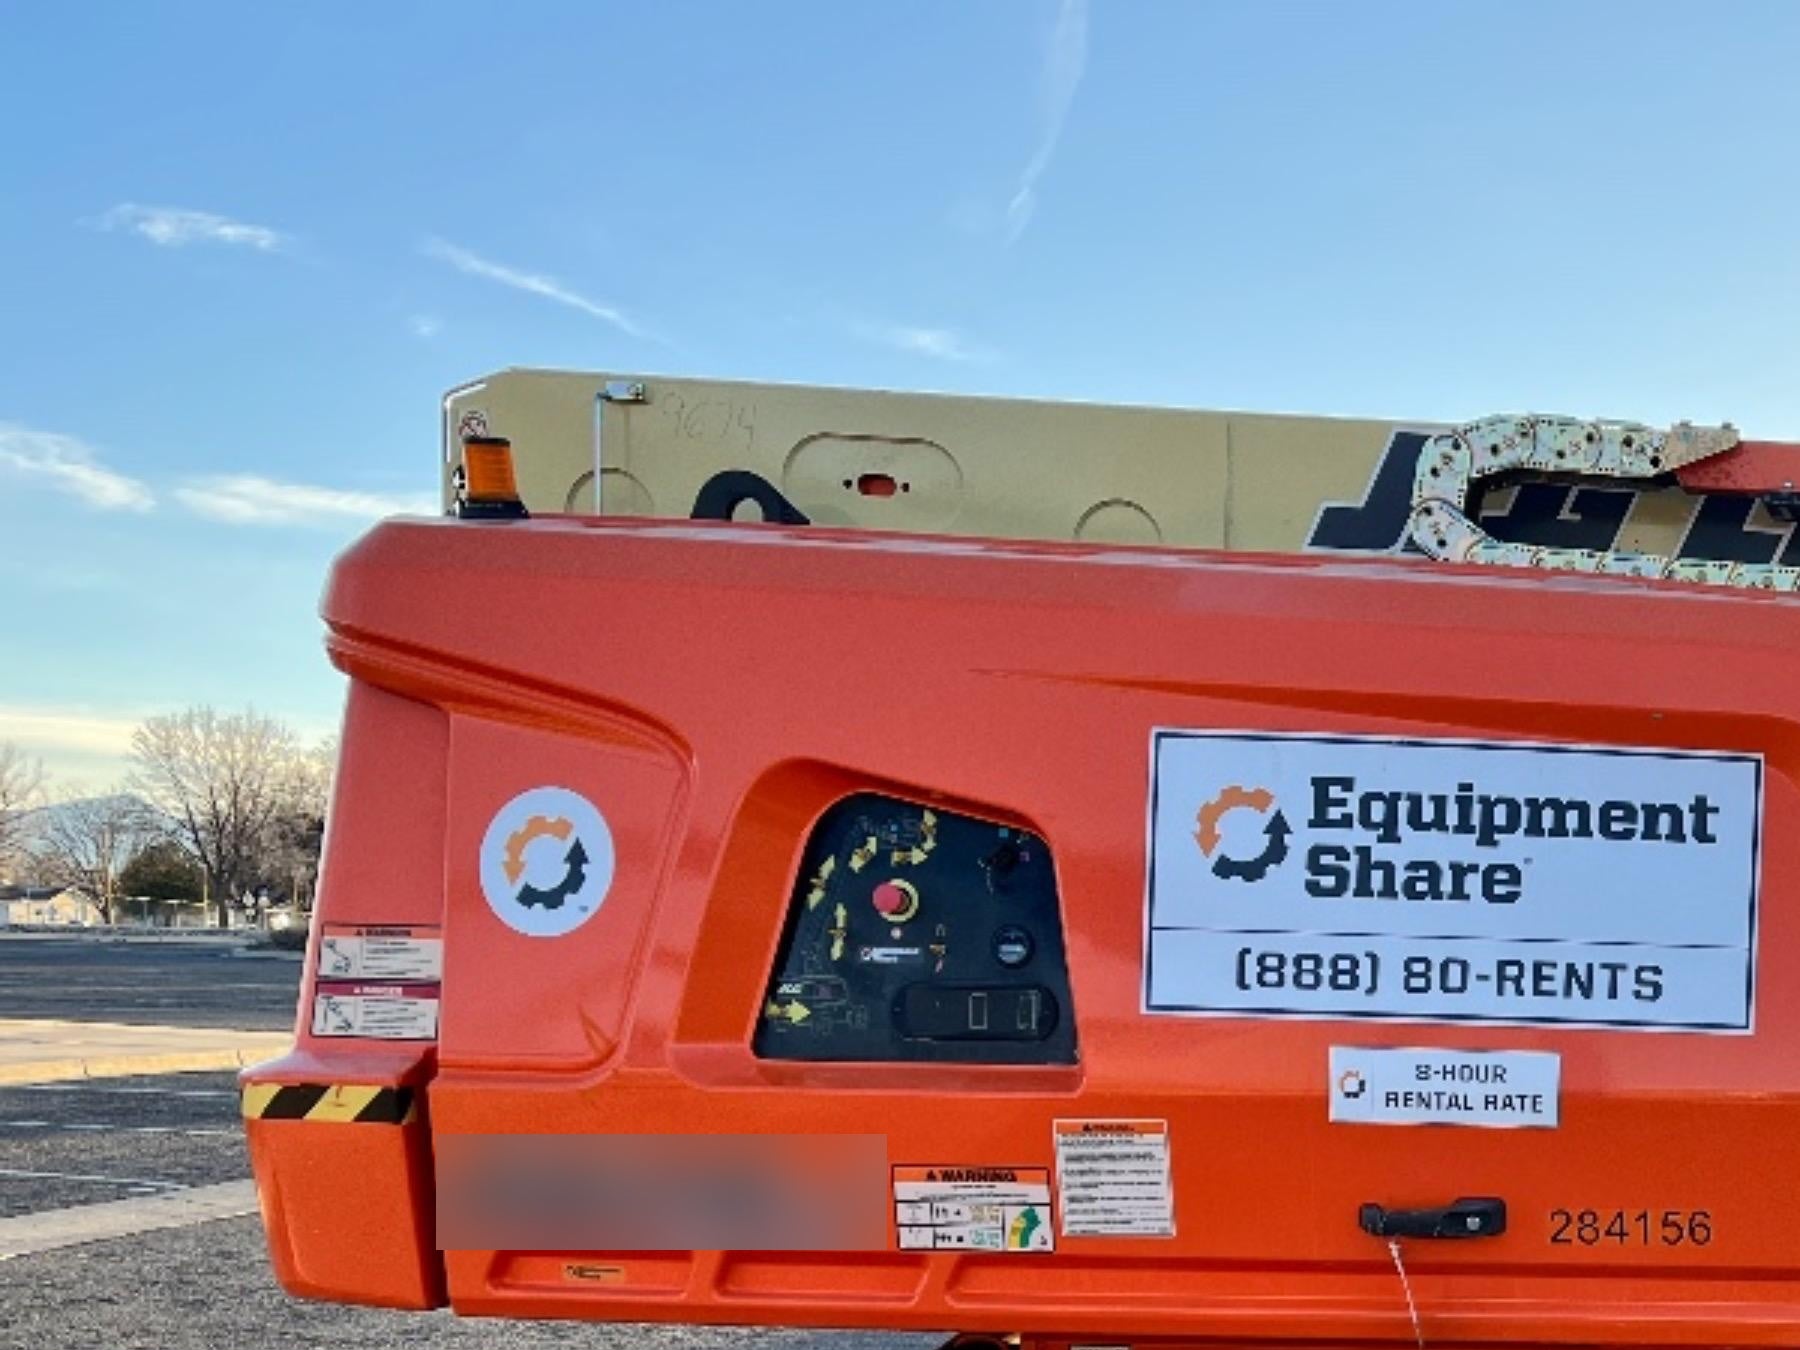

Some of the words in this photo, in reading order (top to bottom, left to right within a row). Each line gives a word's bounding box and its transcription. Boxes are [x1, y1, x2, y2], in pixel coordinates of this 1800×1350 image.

[1308, 777, 1719, 848] Equipment
[1305, 843, 1522, 904] Share
[1236, 947, 1379, 994] (888)
[1403, 956, 1664, 1002] 80-RENTS
[1414, 1063, 1508, 1084] 8-HOUR
[1384, 1090, 1475, 1112] RENTAL
[1484, 1094, 1544, 1114] RATE
[1550, 1209, 1712, 1246] 284156
